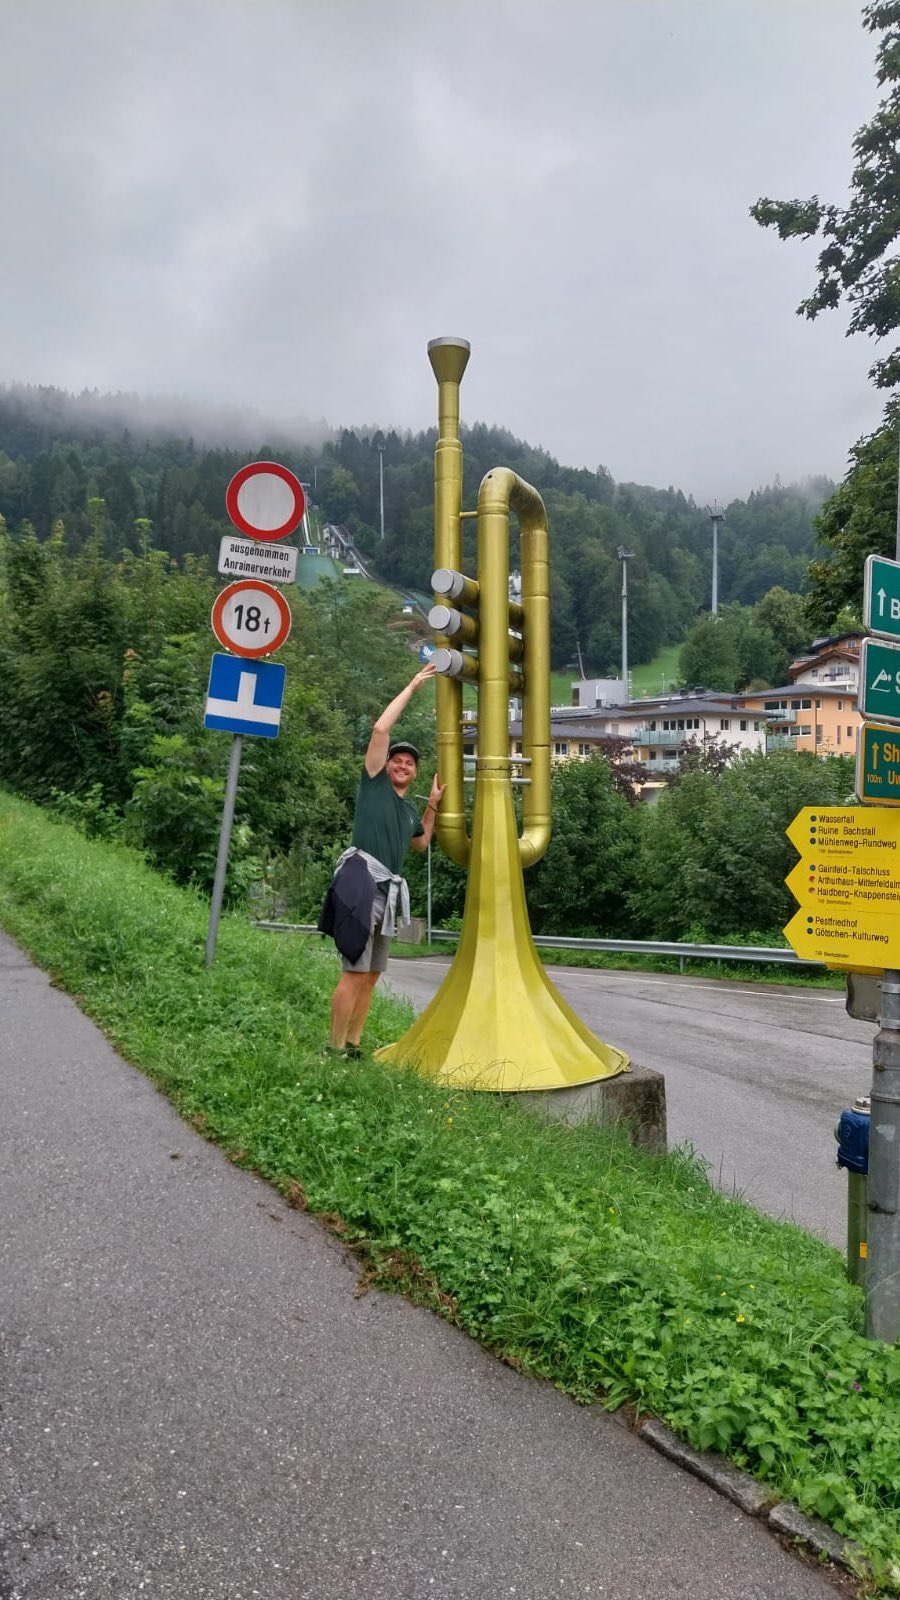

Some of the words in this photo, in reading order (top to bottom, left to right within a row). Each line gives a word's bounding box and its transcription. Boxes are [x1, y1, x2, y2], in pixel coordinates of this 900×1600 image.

[230, 543, 289, 561] ausgenommen
[223, 557, 292, 578] Anrainerverkehr
[234, 604, 261, 632] 18
[819, 815, 855, 824] Wasserfall
[818, 826, 839, 835] Ruine
[818, 837, 897, 849] Mühlenweg-Rundweg
[818, 864, 891, 876] Gainfeld-Talschluss
[815, 916, 858, 928] Pestfriedhof
